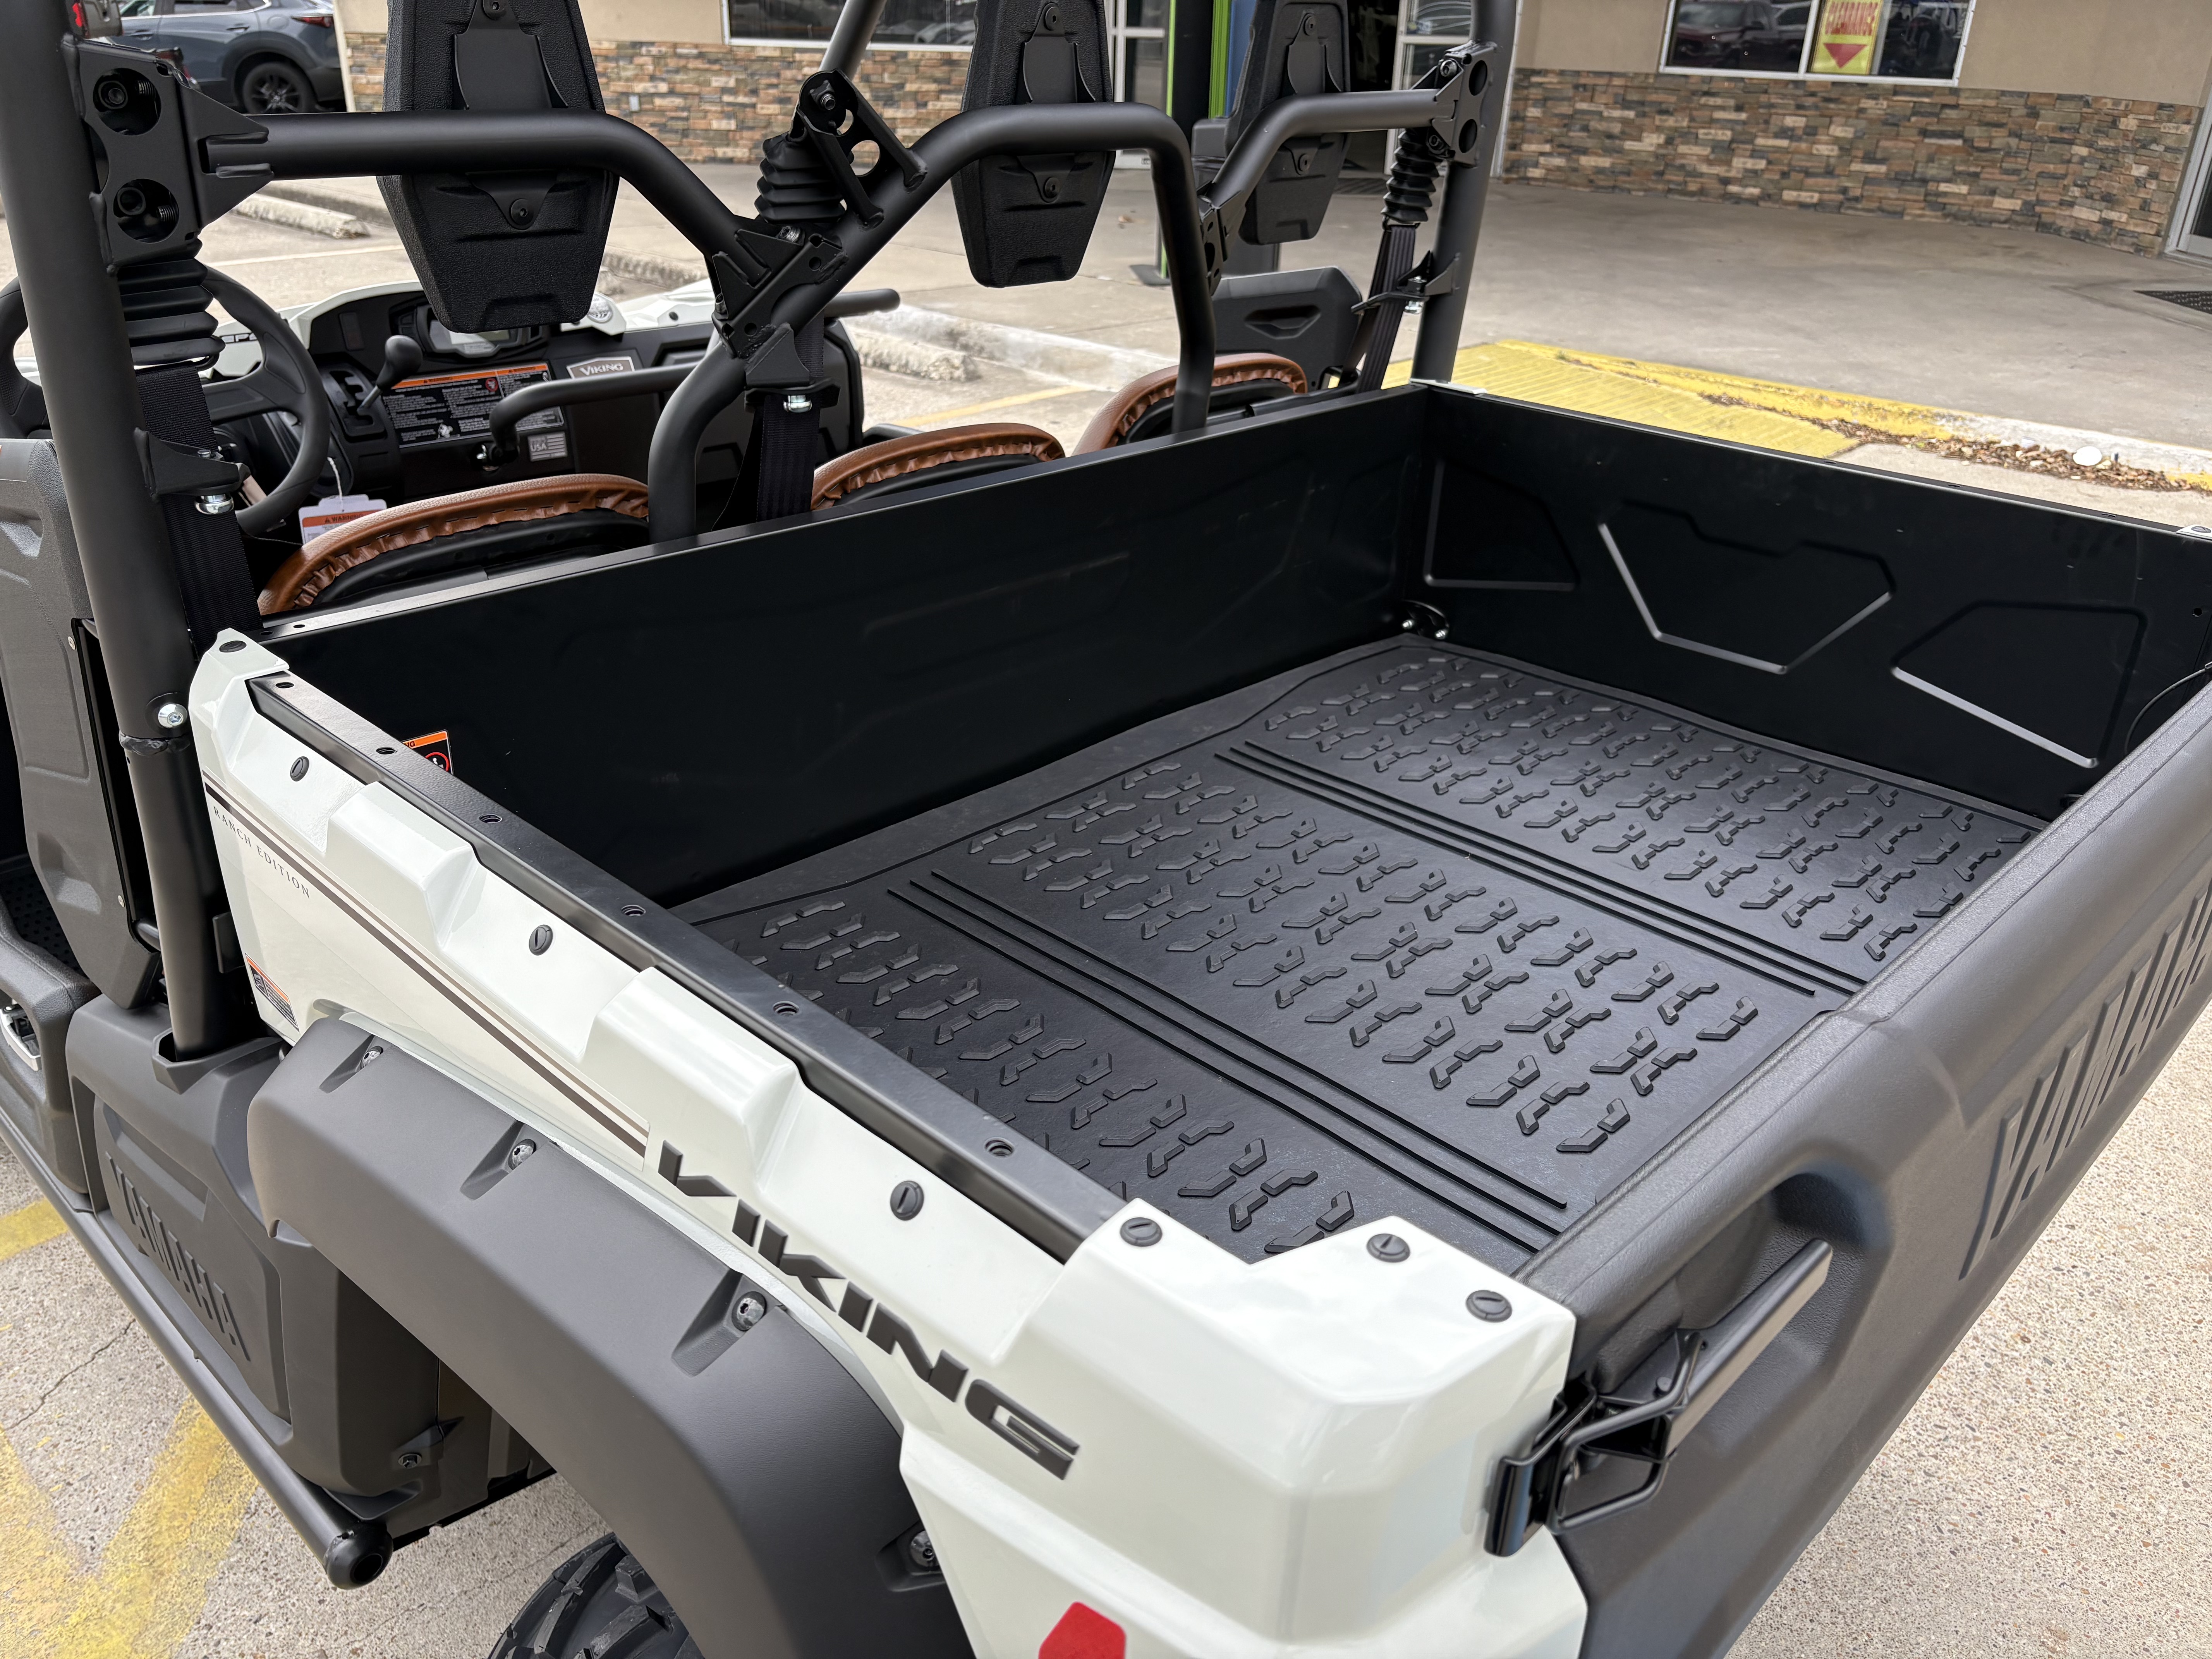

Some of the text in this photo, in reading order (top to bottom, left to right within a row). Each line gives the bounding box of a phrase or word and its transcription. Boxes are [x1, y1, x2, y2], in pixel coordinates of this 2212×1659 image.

[579, 363, 623, 376] VIKING
[213, 805, 310, 899] RANCH EDITION
[105, 1151, 251, 1362] YAMAHA
[658, 1140, 1080, 1480] VIKING
